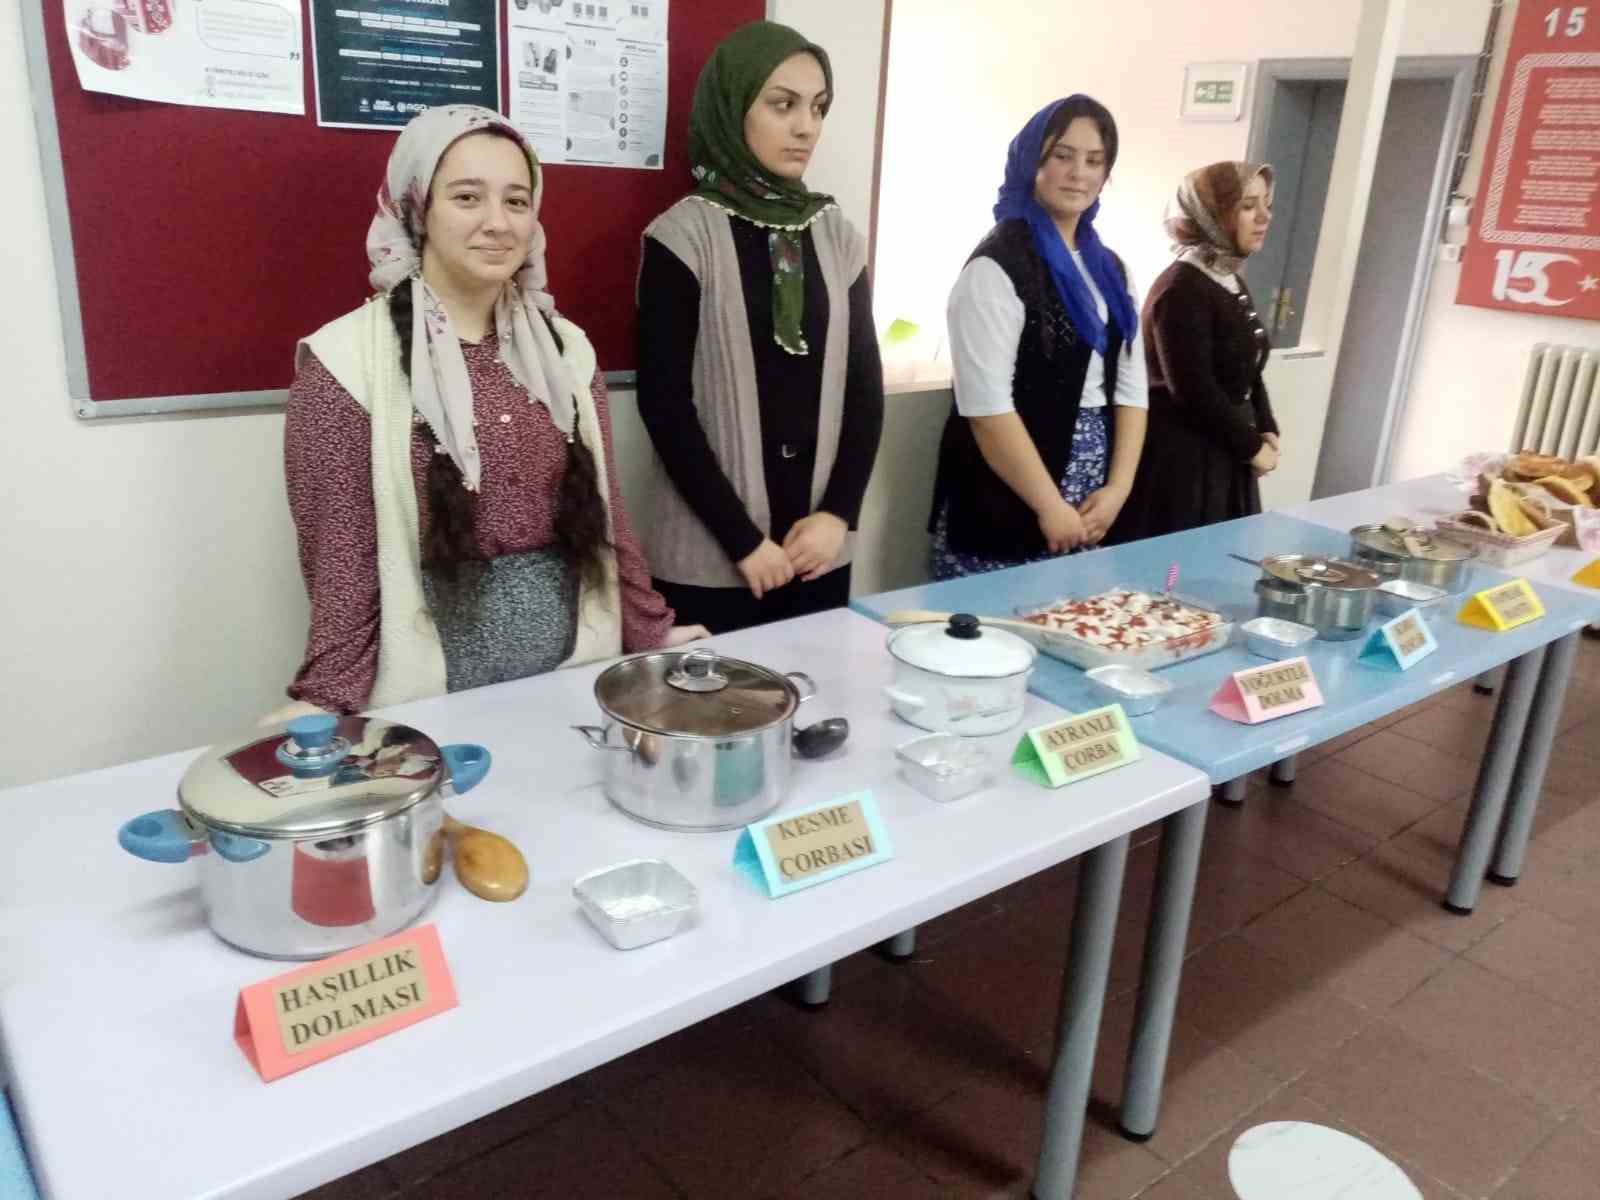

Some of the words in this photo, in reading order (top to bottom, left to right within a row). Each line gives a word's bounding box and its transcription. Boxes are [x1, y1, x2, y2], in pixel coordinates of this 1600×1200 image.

[1544, 6, 1588, 38] 15
[776, 805, 854, 841] KESME
[779, 834, 875, 880] ÇORBASI
[279, 949, 417, 1013] HAŞILLIK
[290, 982, 424, 1046] DOLMASI
